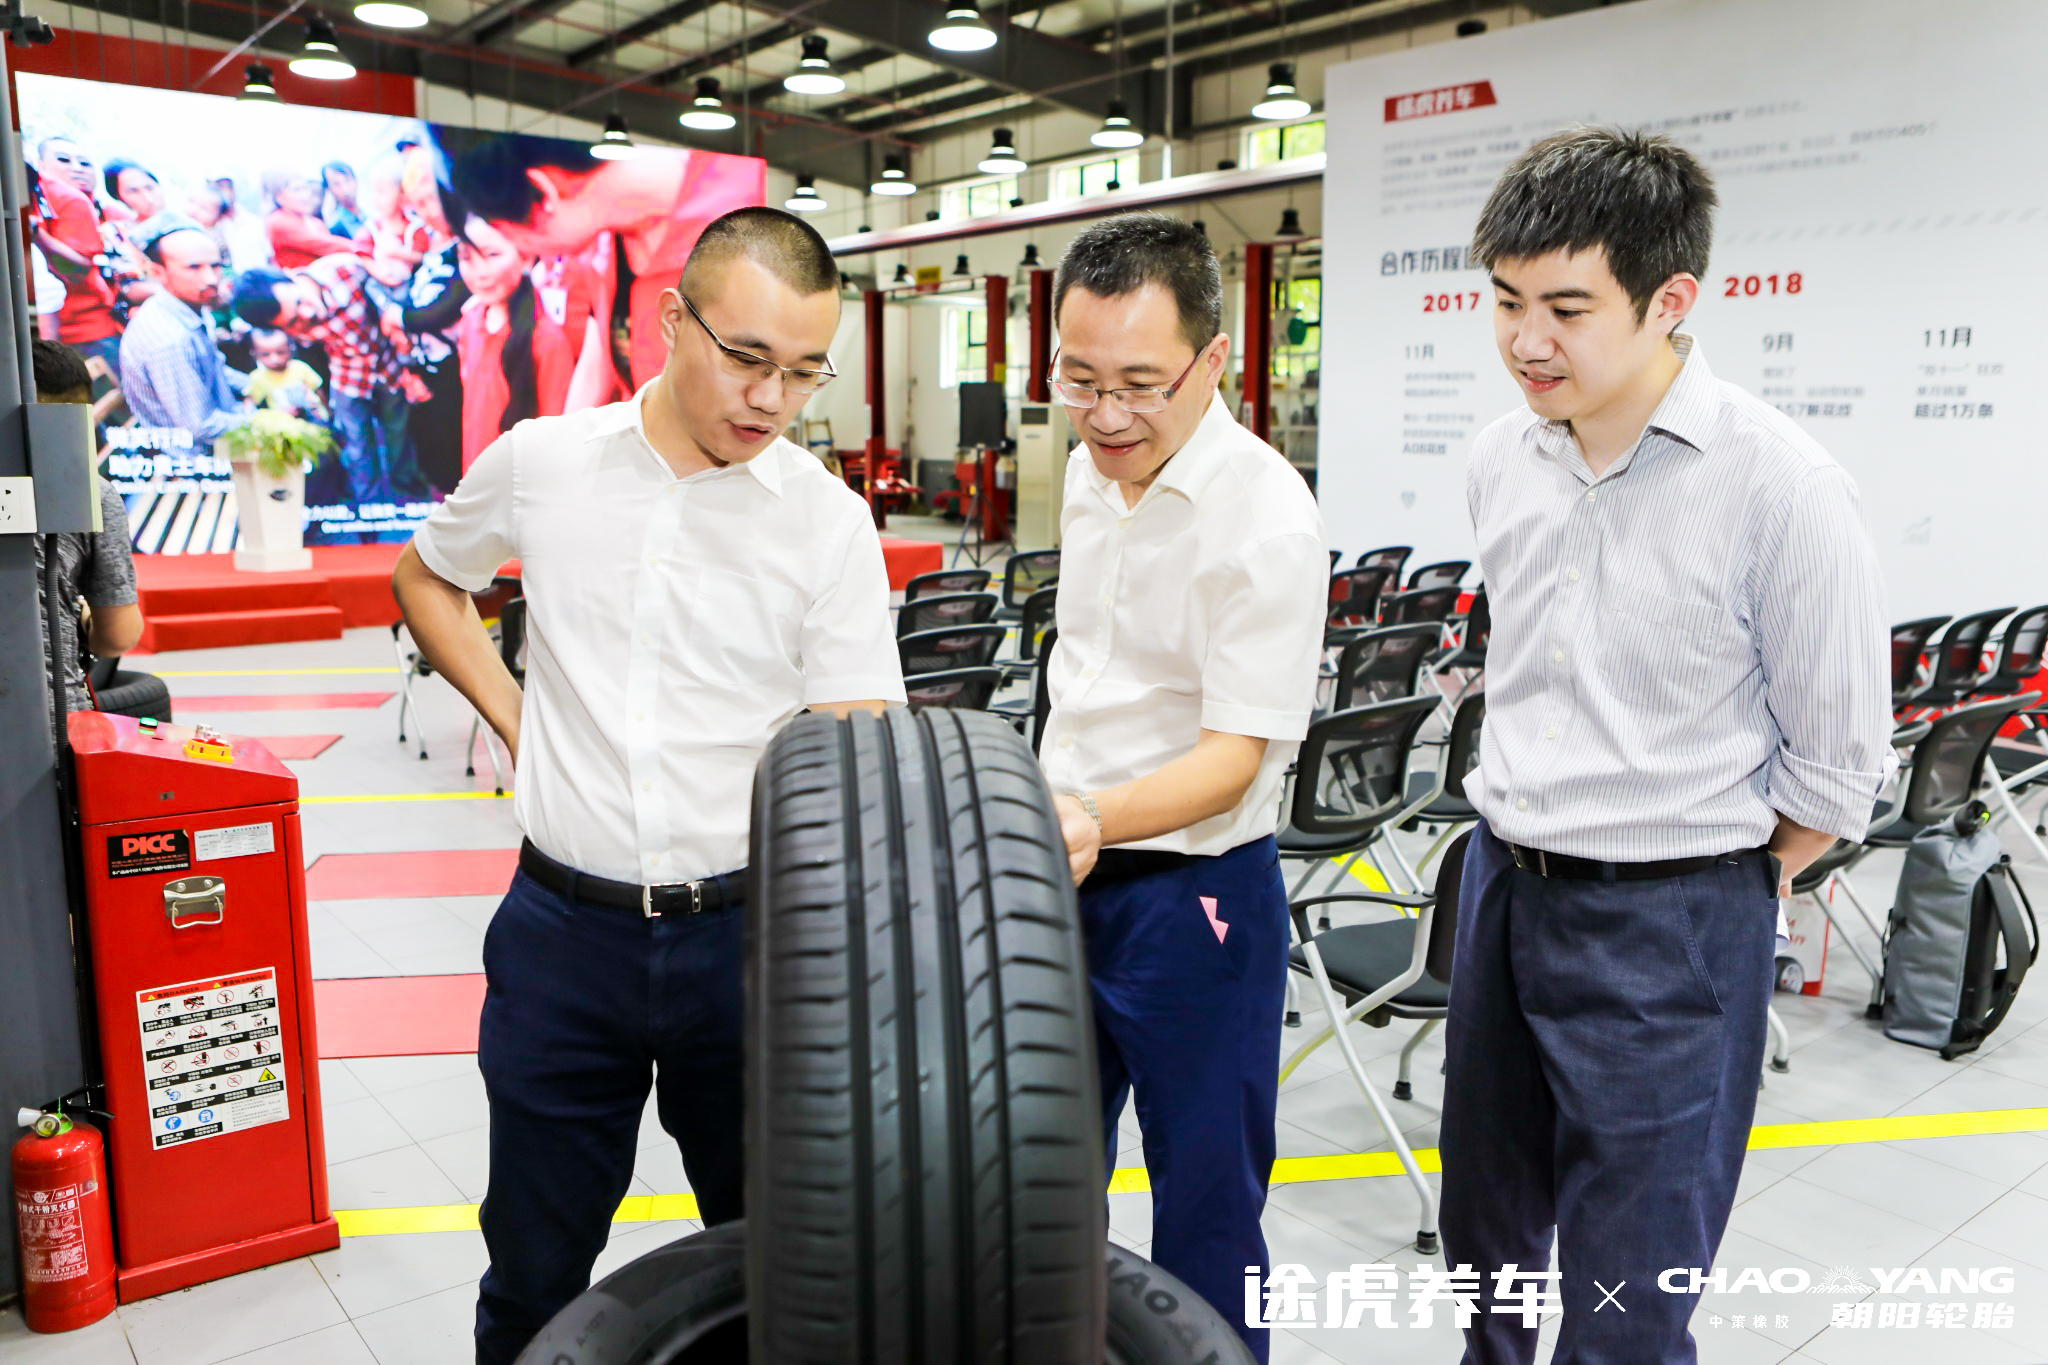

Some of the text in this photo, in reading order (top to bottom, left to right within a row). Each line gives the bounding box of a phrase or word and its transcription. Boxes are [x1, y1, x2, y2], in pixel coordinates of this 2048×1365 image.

[1724, 273, 1804, 297] 2018
[1423, 291, 1481, 312] 2017
[1762, 333, 1794, 353] 9月
[1922, 326, 1972, 348] 11月
[122, 833, 176, 857] PICC
